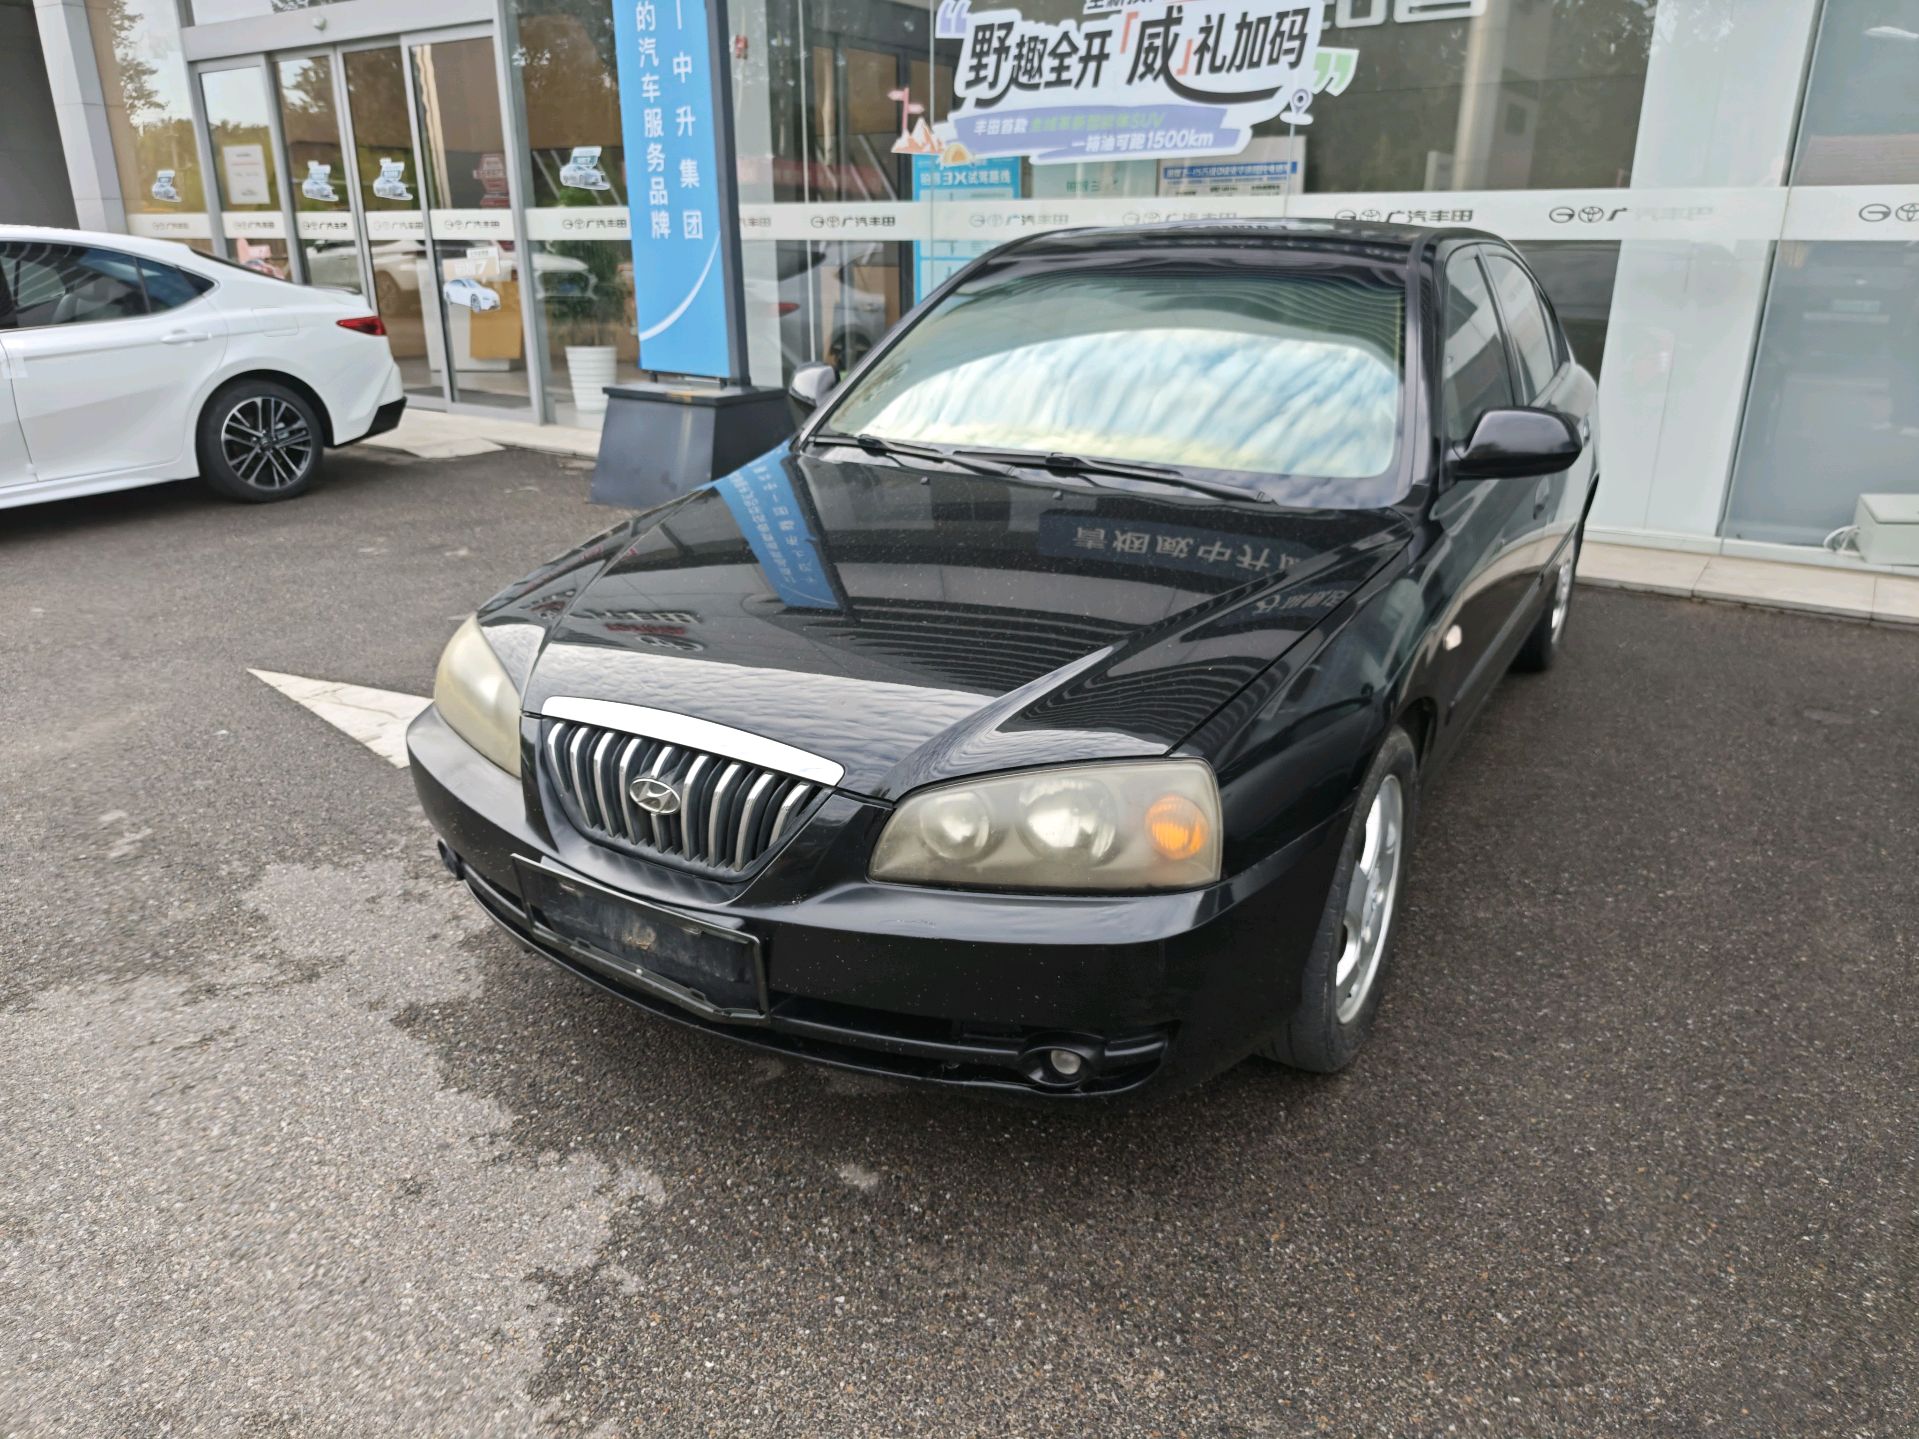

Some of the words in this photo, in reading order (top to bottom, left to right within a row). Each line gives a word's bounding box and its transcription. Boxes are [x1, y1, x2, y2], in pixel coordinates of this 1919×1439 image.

[635, 0, 671, 240] 的汽车服务品牌
[842, 216, 896, 228] 广汽丰田
[1005, 213, 1070, 226] 广汽丰田
[1386, 209, 1474, 223] 广汽丰田
[585, 219, 627, 229] 广汽丰田
